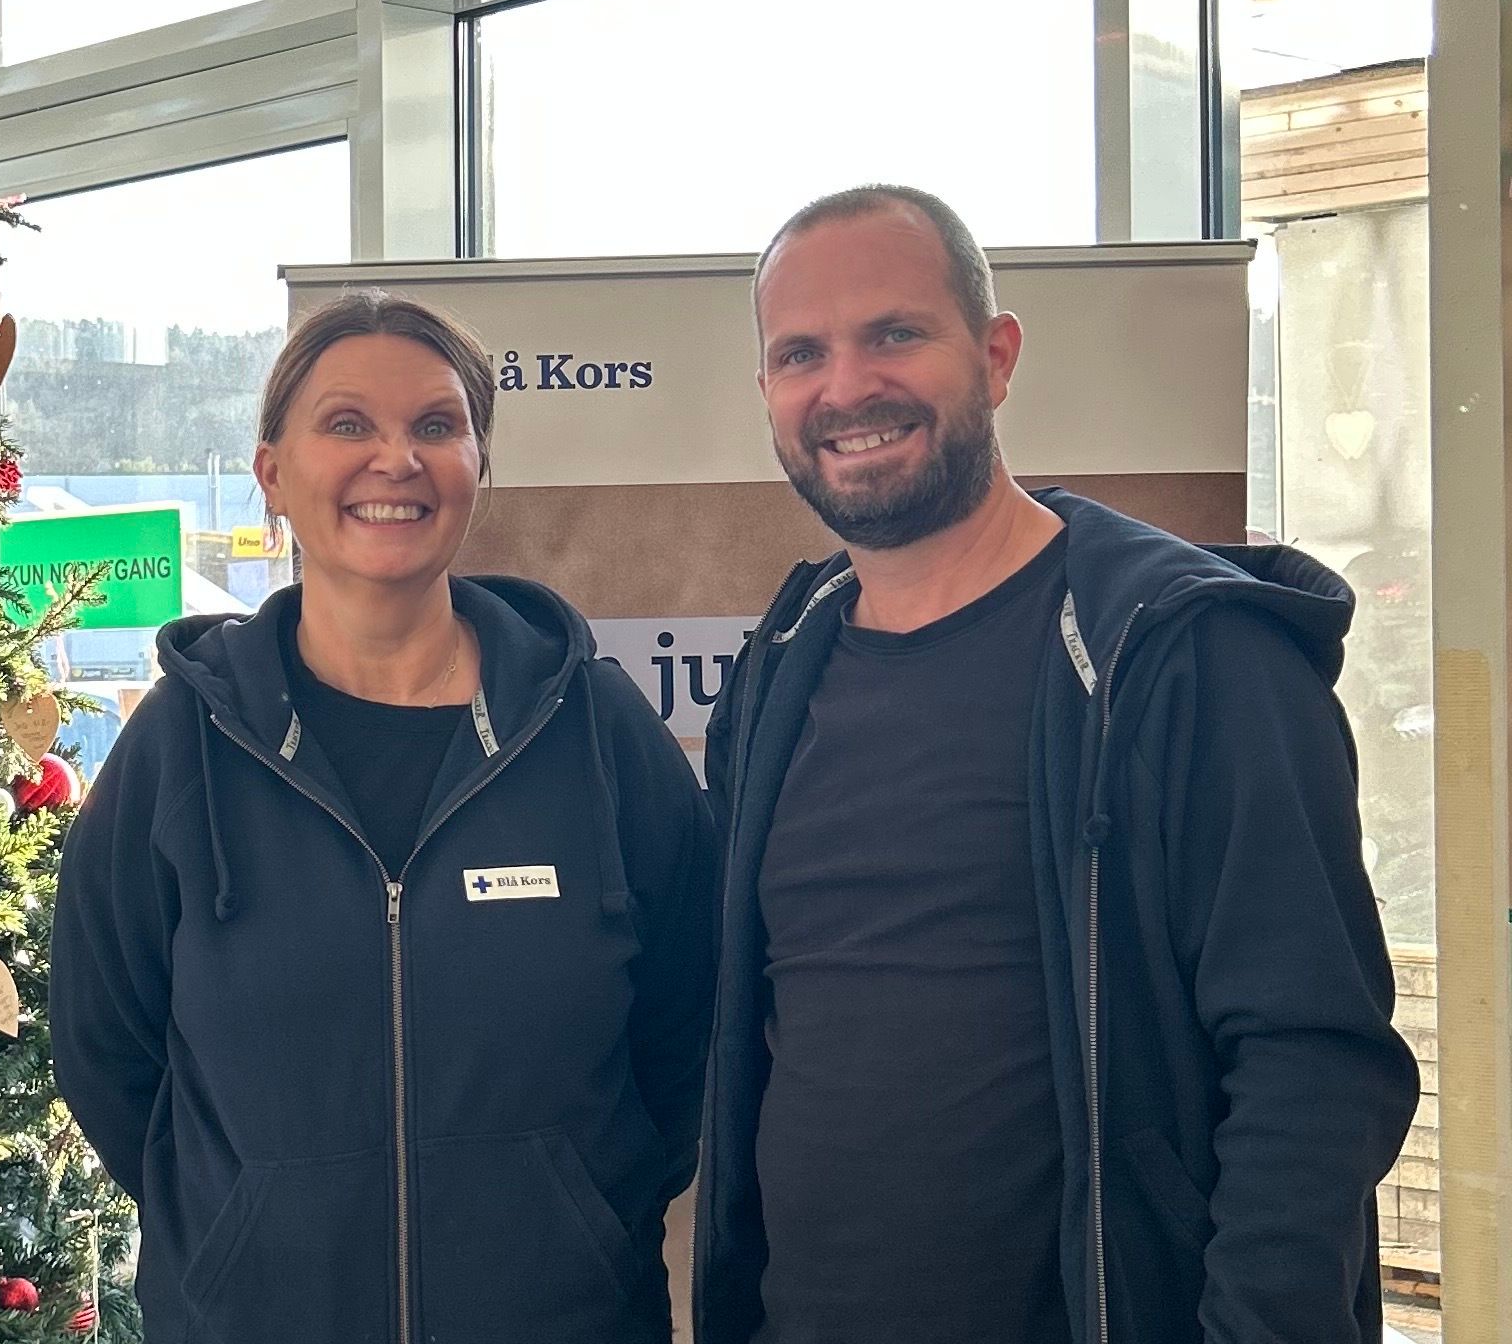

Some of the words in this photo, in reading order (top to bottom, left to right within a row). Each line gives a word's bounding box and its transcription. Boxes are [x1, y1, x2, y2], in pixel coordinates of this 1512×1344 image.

[536, 354, 653, 390] Kors
[8, 563, 44, 587] KUN
[50, 556, 172, 584] NØDTGANG
[651, 630, 756, 722] ju
[496, 875, 518, 887] Blå
[520, 875, 551, 886] Kors
